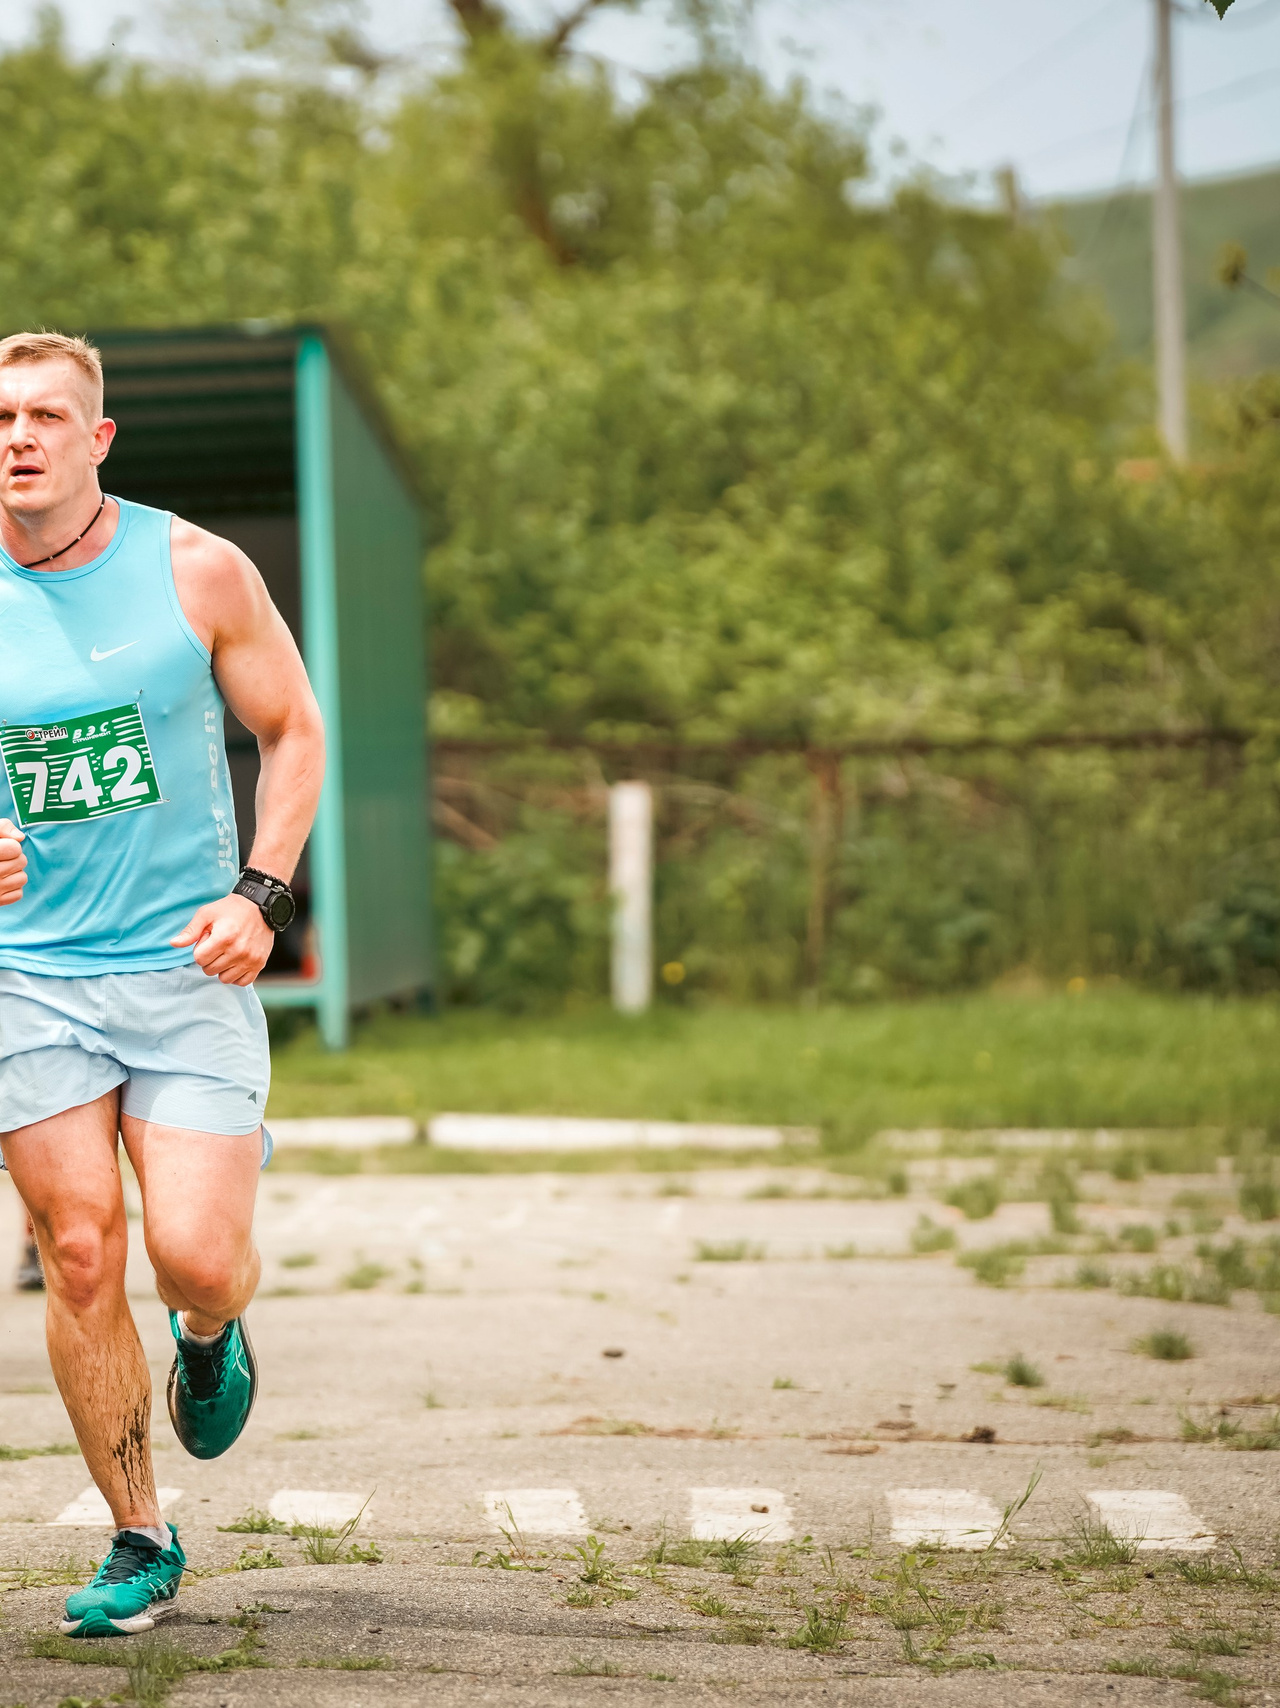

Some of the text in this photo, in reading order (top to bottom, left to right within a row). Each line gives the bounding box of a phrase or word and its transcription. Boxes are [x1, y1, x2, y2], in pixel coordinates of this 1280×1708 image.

[15, 745, 150, 814] 742
[203, 710, 236, 876] JUST DO IT
